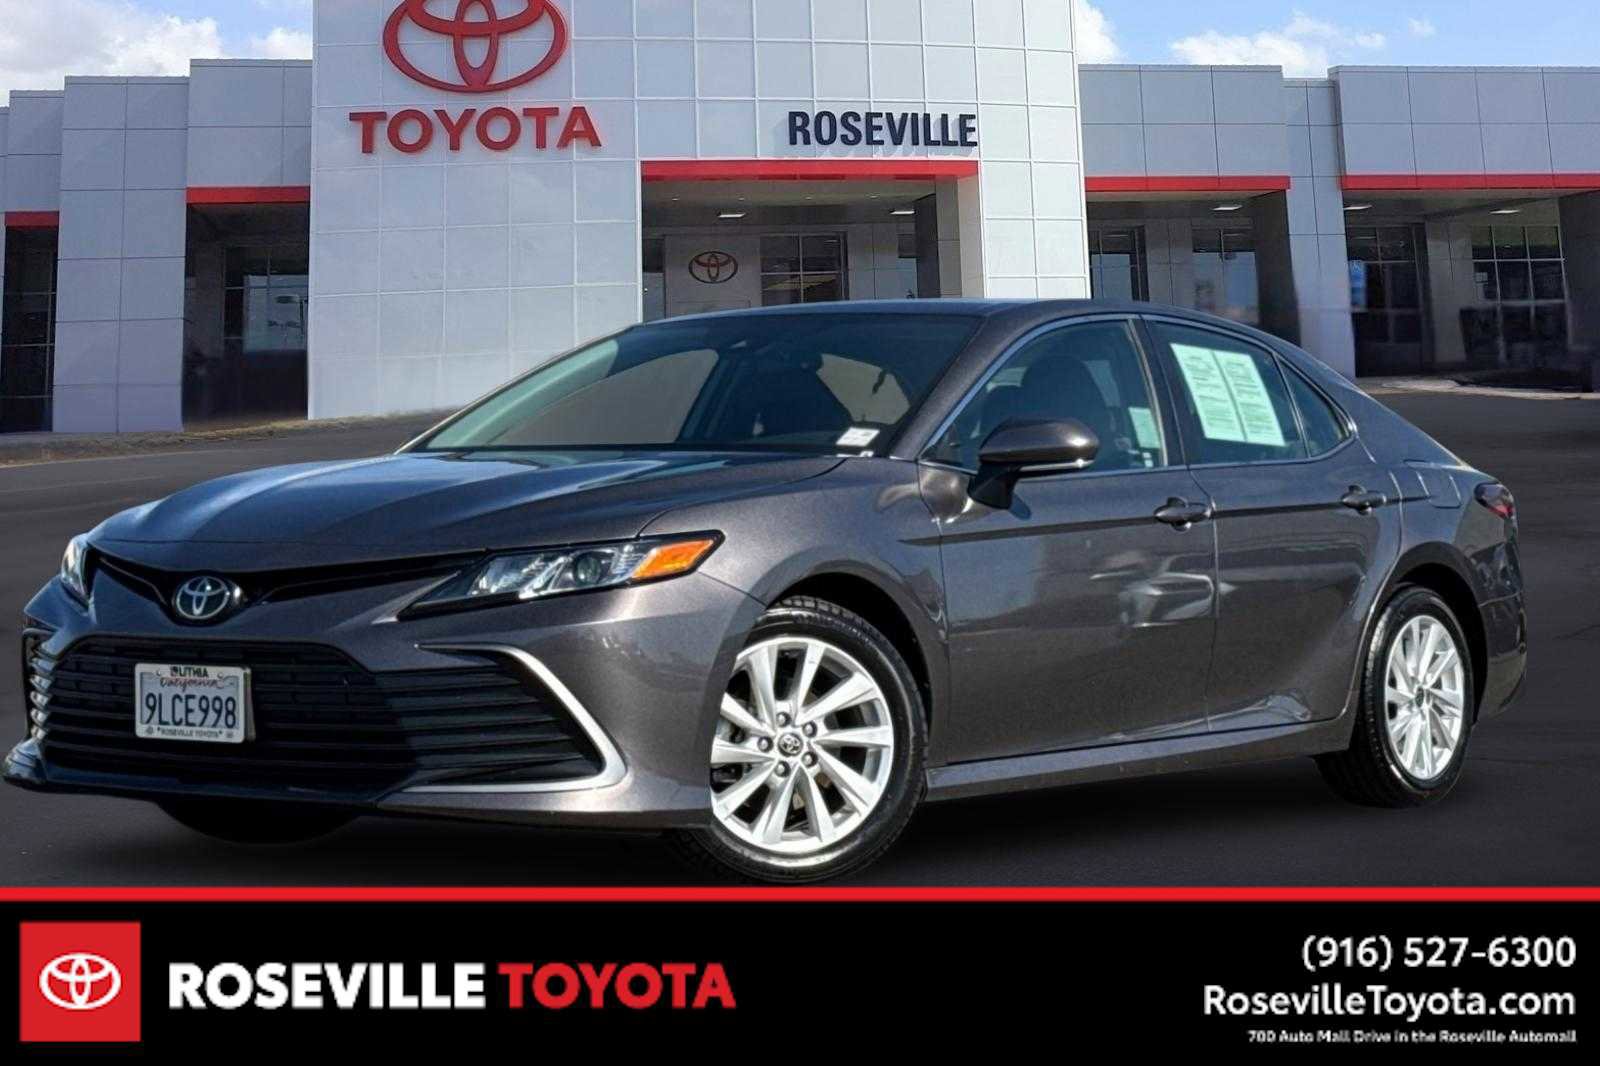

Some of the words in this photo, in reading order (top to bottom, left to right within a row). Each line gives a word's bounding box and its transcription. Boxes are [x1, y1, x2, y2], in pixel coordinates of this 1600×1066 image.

[350, 106, 602, 154] TOYOTA
[789, 111, 978, 147] ROSEVILLE
[160, 677, 221, 692] California
[179, 666, 209, 678] LITHIA
[145, 692, 237, 729] 9LCE998
